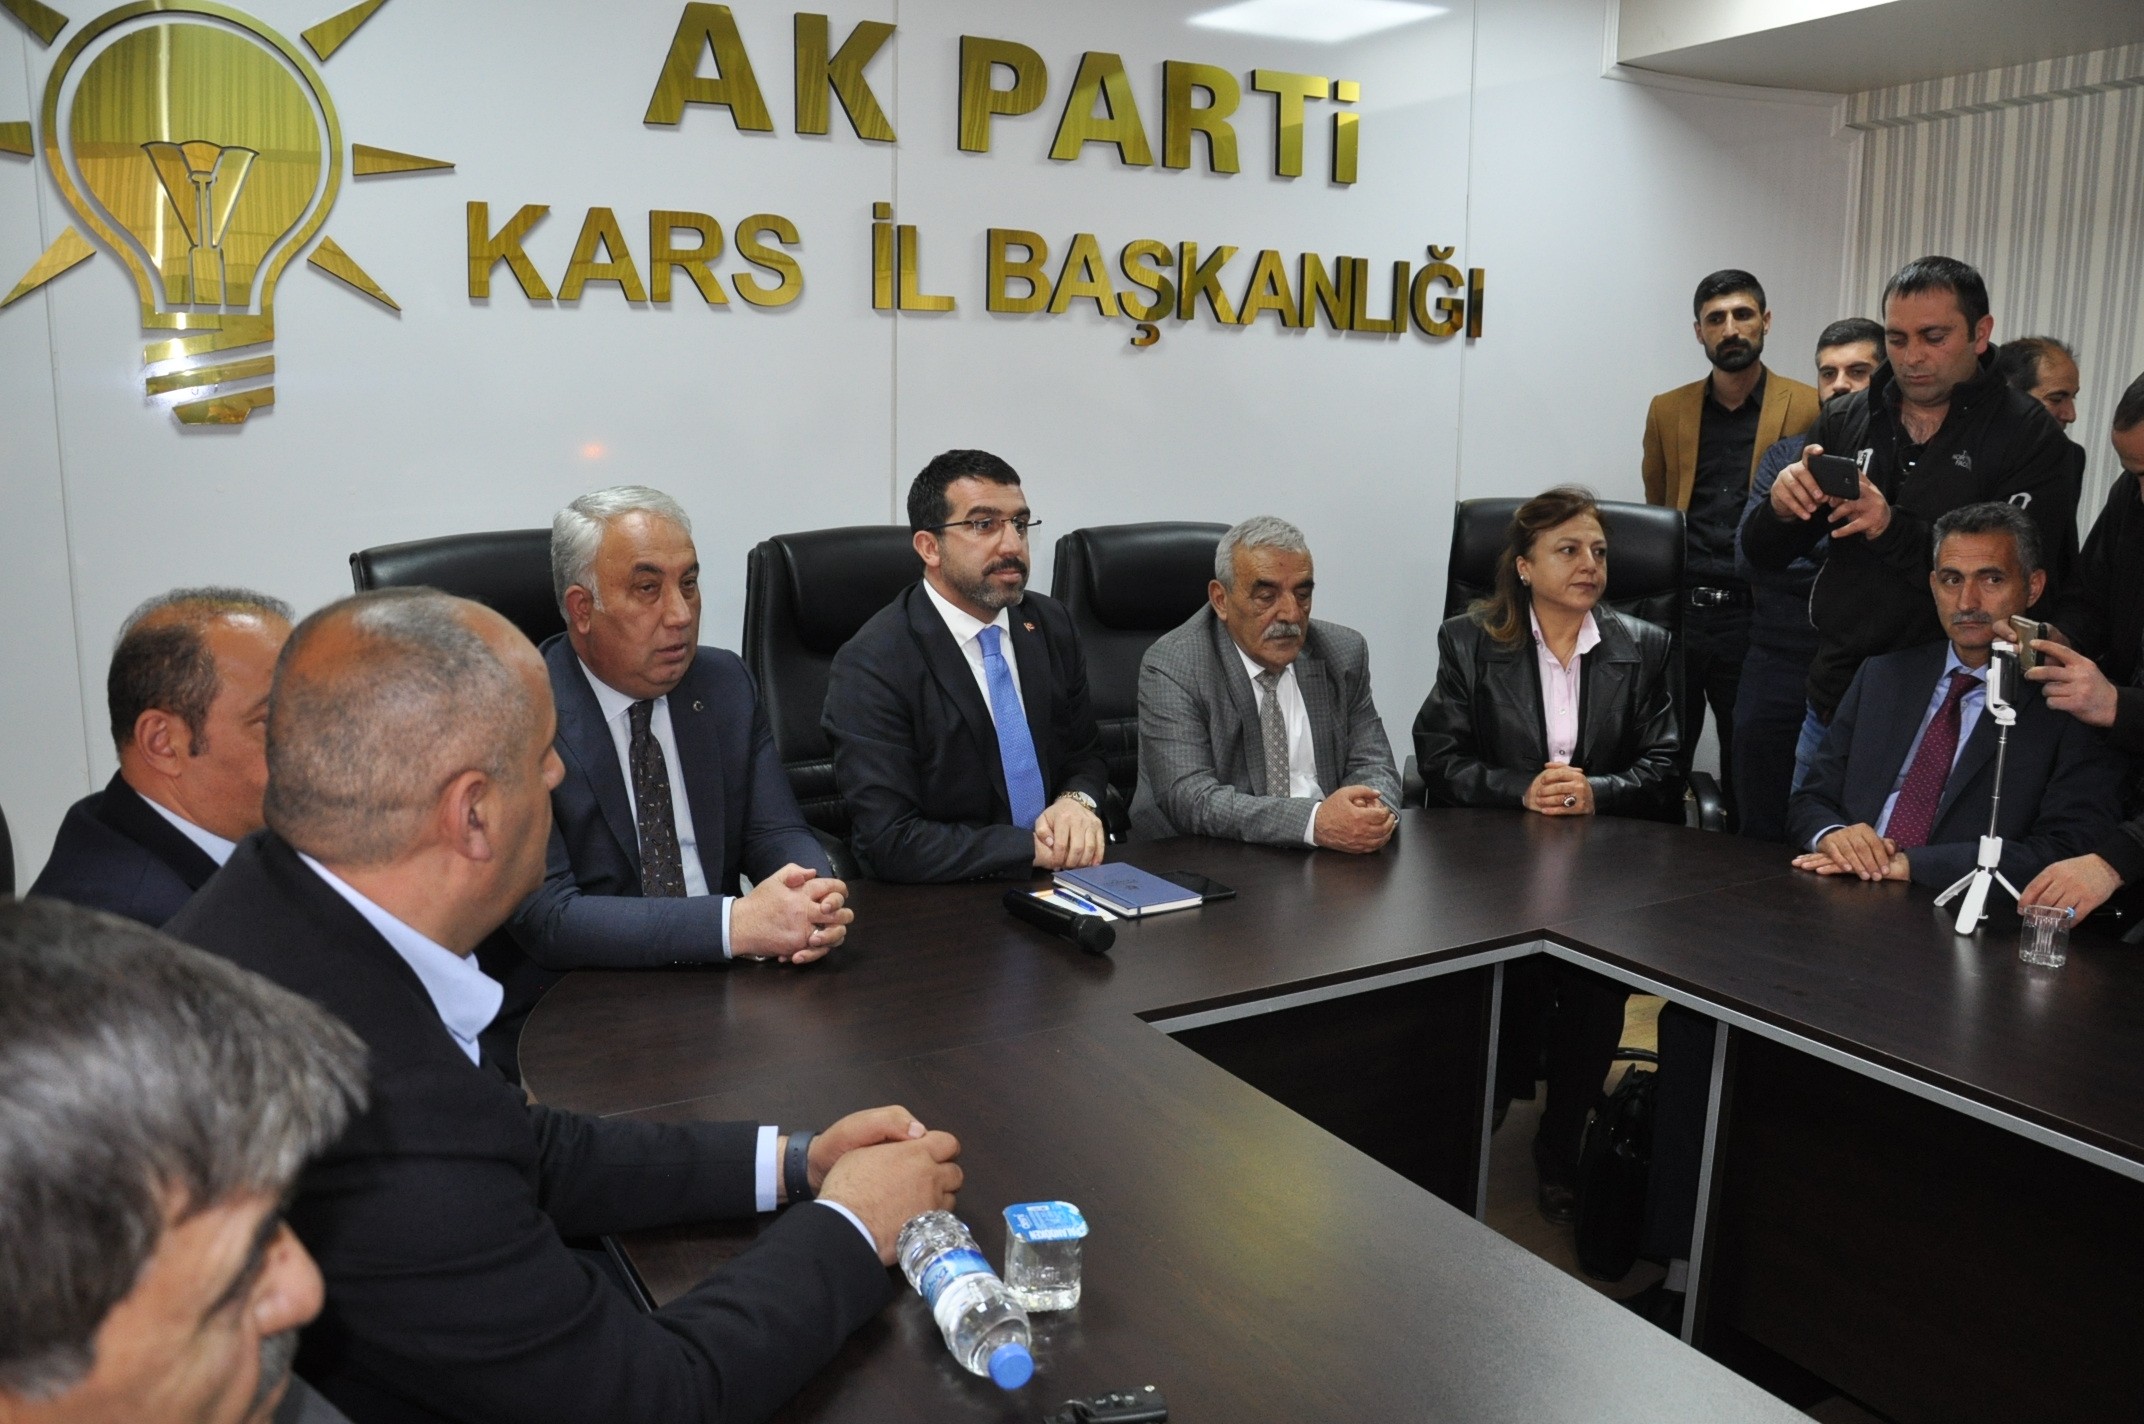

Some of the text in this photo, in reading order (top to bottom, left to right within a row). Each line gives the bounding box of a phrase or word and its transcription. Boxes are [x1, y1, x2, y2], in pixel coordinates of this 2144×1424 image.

[643, 1, 897, 143] AK
[467, 200, 1485, 348] KARS İL BAŞKANLIĞI
